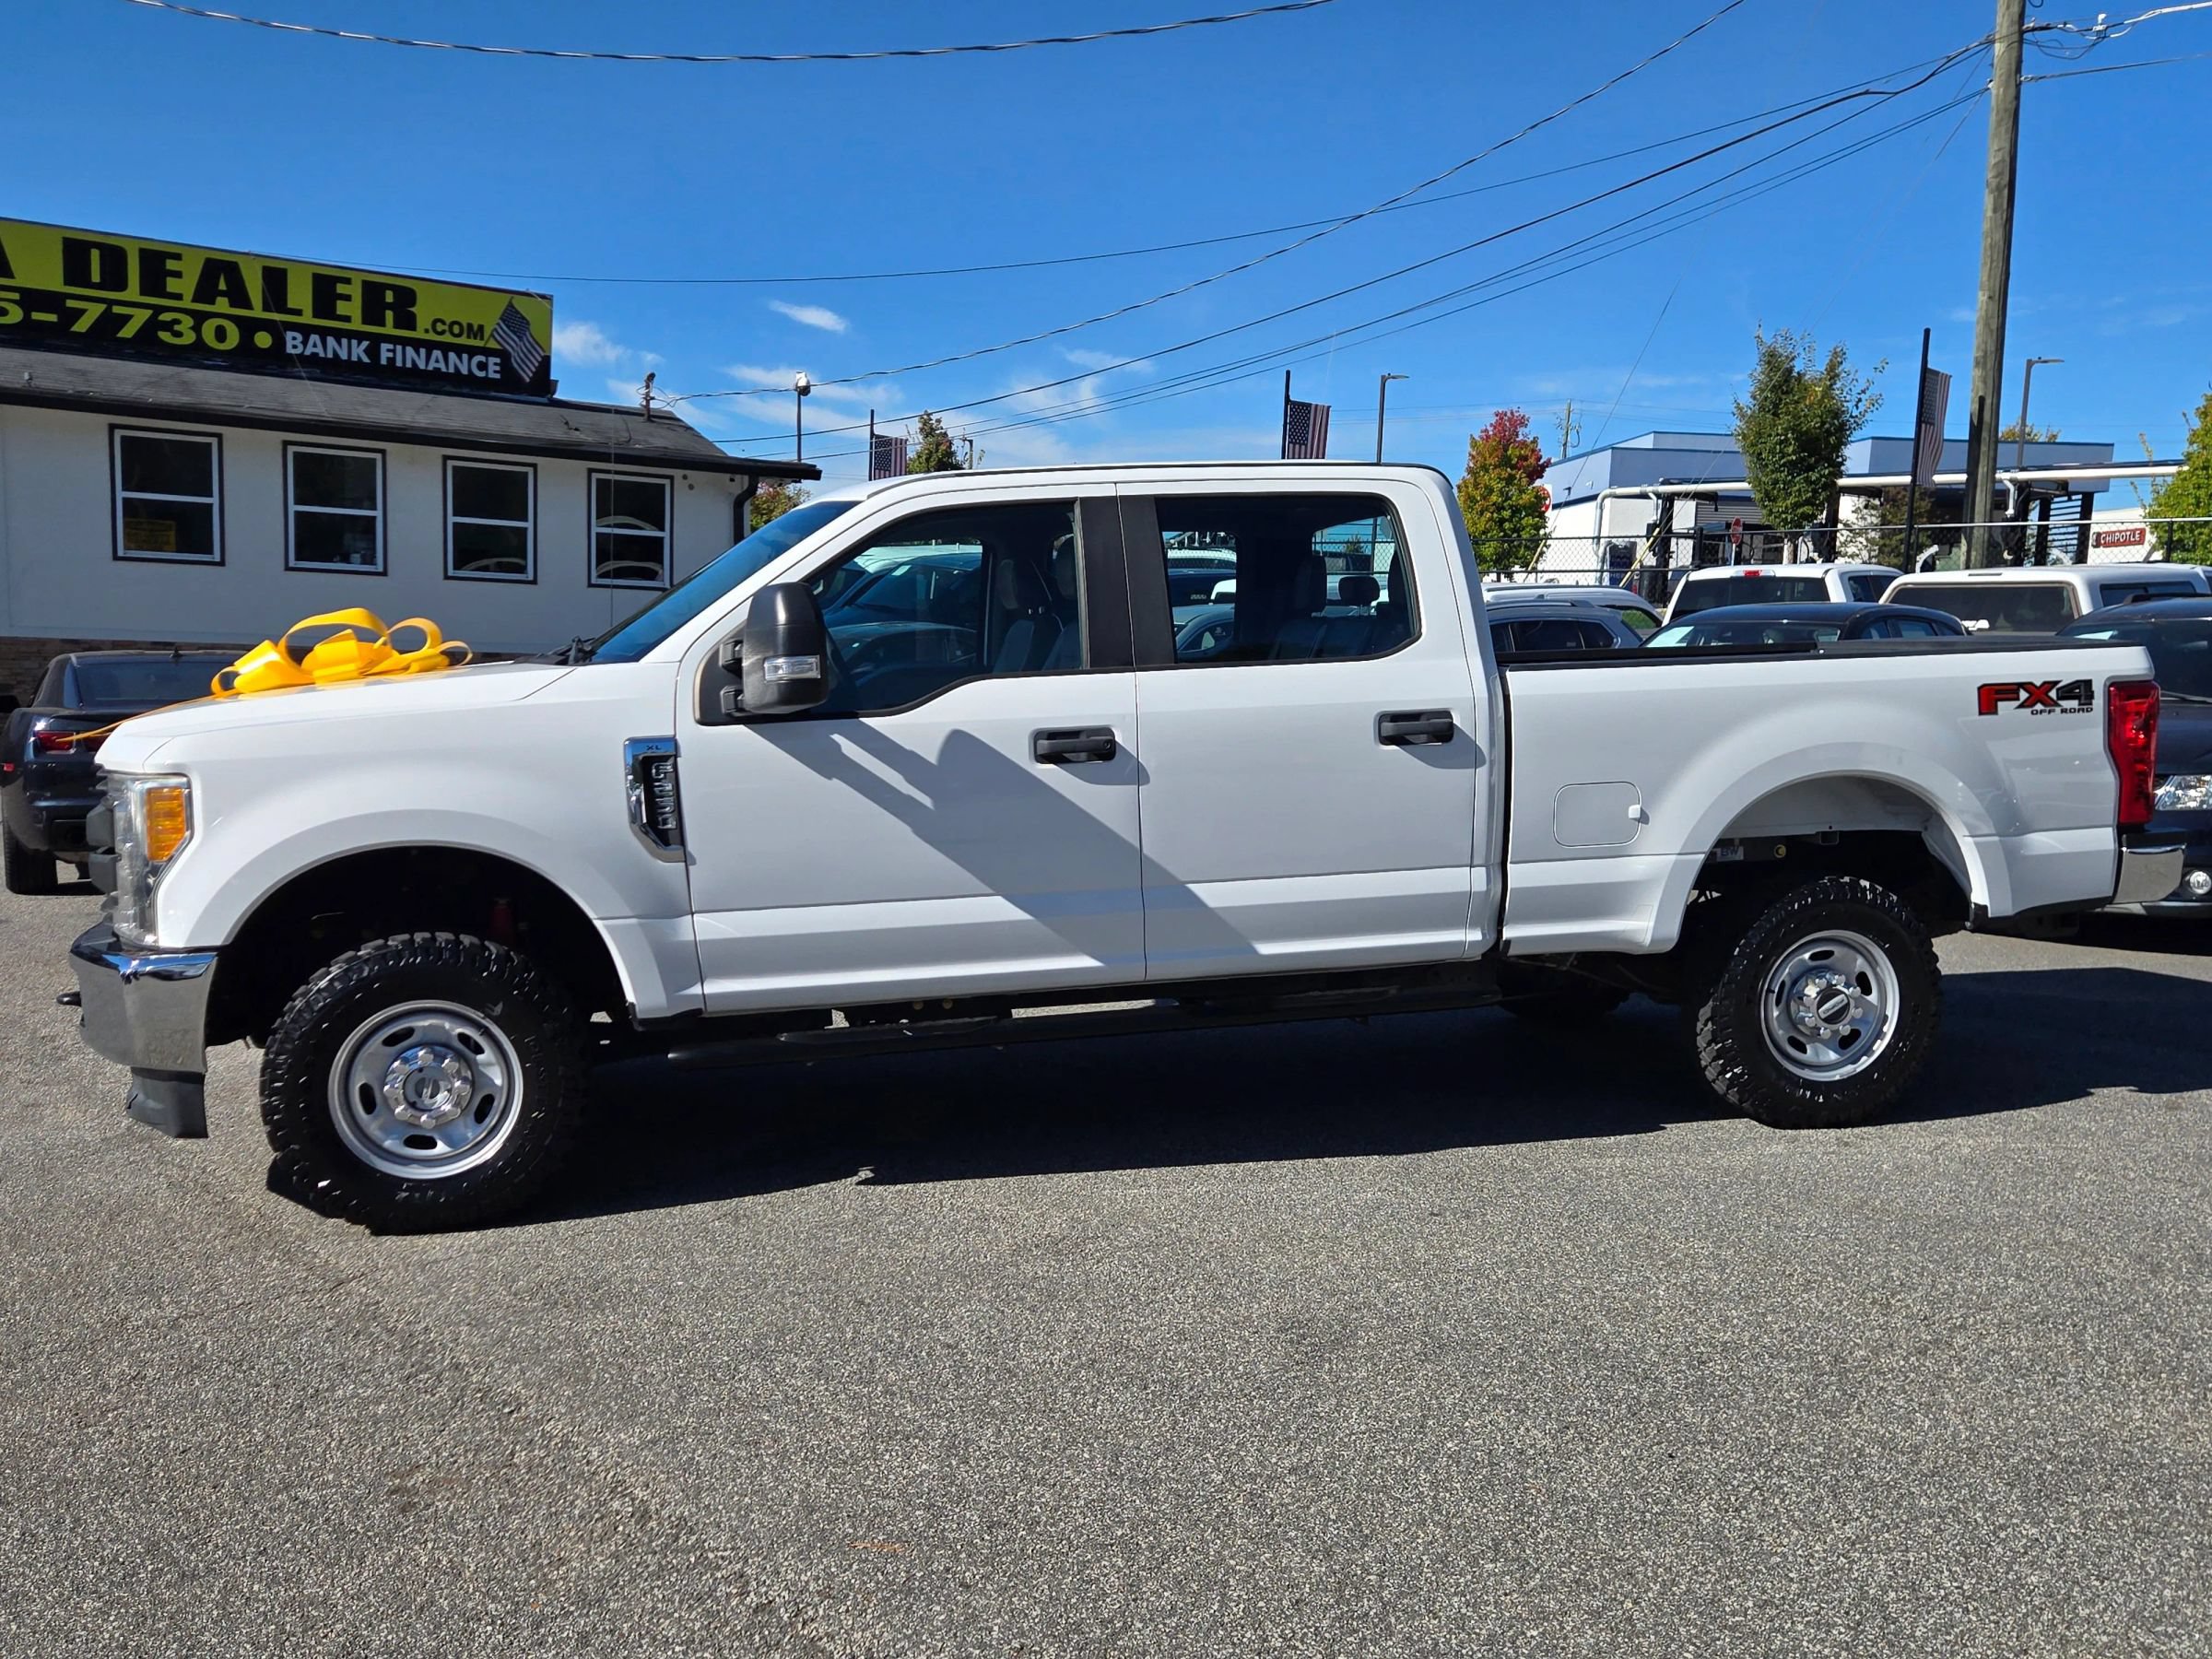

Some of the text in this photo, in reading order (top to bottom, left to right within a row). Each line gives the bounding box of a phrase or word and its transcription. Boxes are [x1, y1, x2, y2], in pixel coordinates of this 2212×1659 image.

[285, 330, 501, 379] BANK FINANCE
[2100, 530, 2140, 544] CHIPOTLE
[1977, 678, 2094, 715] FX4
